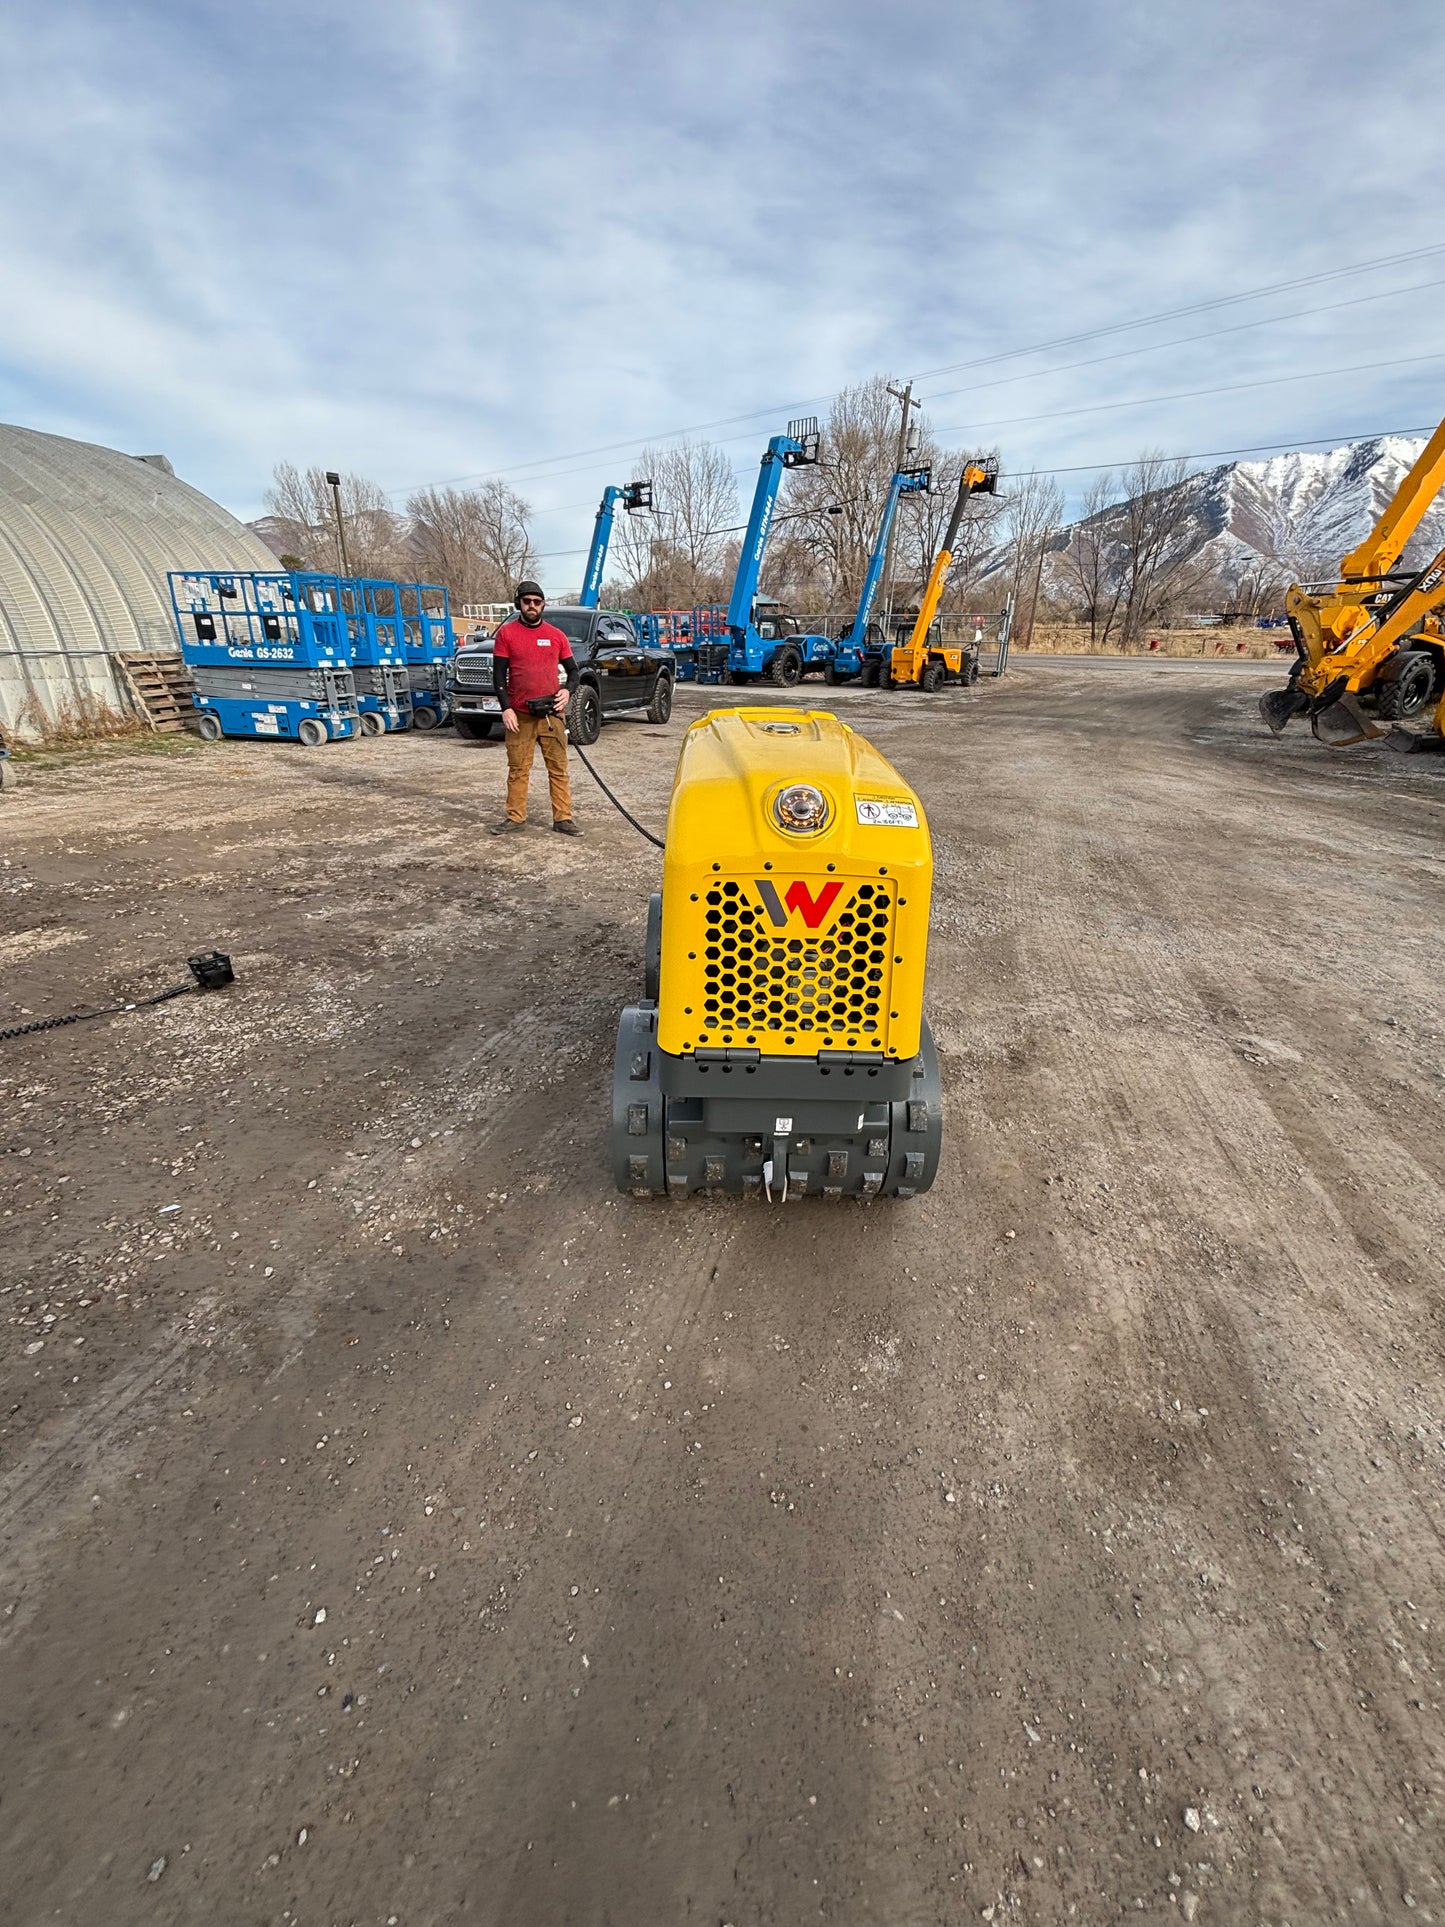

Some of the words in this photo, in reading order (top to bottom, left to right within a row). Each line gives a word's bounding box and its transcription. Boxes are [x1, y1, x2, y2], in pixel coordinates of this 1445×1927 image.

[754, 537, 764, 561] Genie
[1374, 593, 1394, 603] CAT
[228, 646, 254, 658] Genie
[257, 648, 294, 659] GS-2632
